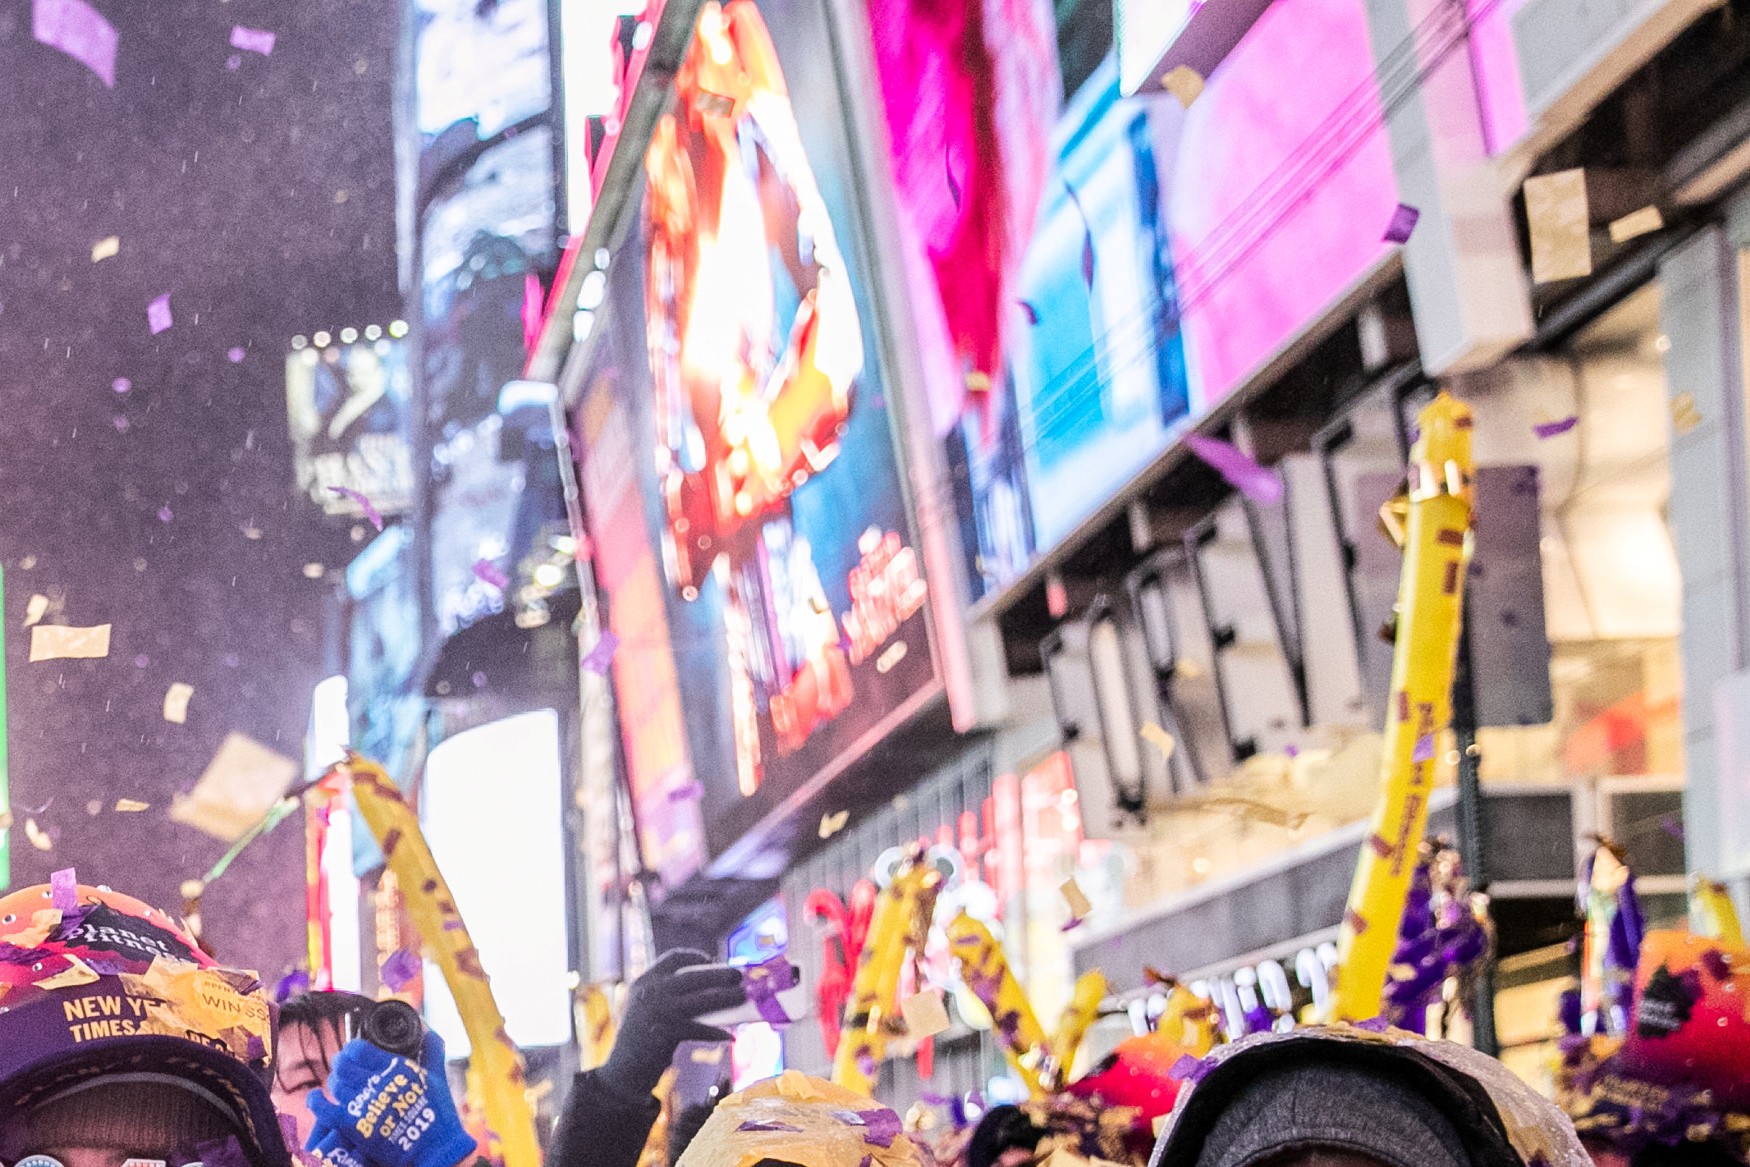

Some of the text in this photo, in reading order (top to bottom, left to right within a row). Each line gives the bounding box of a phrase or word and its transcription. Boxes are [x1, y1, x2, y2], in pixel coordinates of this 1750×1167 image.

[63, 996, 121, 1022] NEW
[70, 1019, 136, 1044] TIMES
[356, 1074, 408, 1139] Believe
[380, 1116, 397, 1138] or
[398, 1107, 436, 1151] 2019
